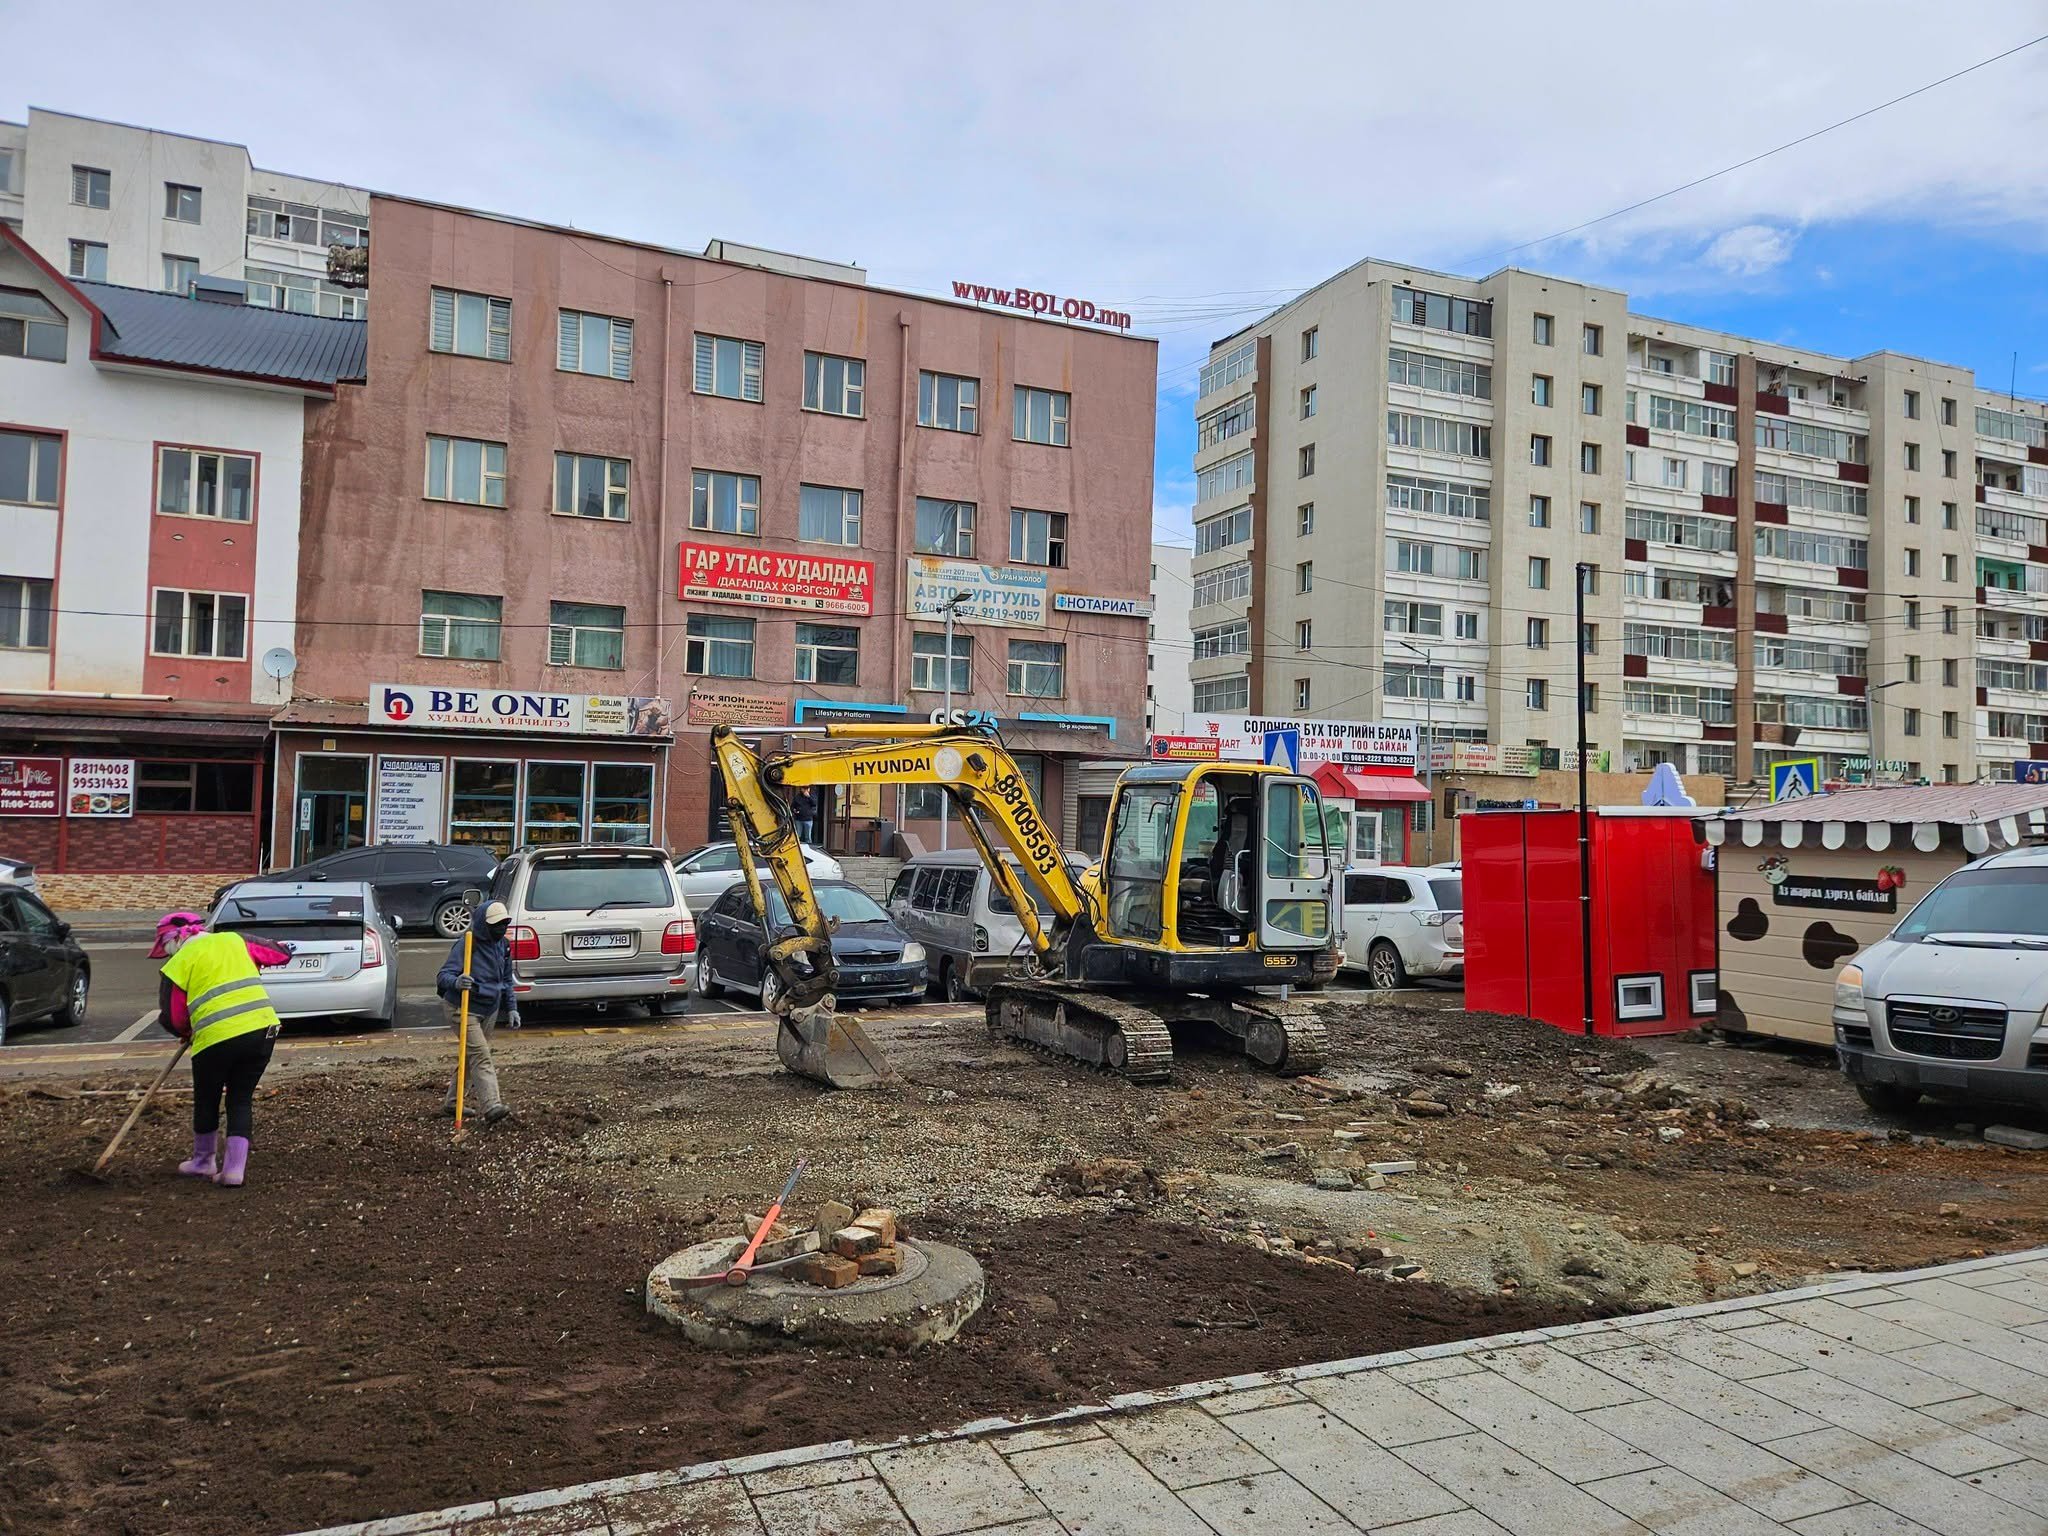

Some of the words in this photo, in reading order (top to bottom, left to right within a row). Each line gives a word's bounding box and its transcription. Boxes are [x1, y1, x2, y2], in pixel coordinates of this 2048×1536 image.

[952, 281, 1131, 329] www.BOLOD.mn
[685, 548, 720, 570] ГАР
[725, 552, 771, 576] УТАС
[775, 558, 868, 586] ХУДАЛДАА
[914, 584, 957, 599] АВТО
[825, 601, 867, 612] 9666-6005
[1067, 597, 1135, 613] НОТАРИАТ
[428, 690, 479, 714] BE
[492, 694, 571, 719] ONE
[428, 714, 492, 724] ХУДАЛДАА
[696, 710, 717, 718] ГАР
[722, 711, 749, 720] УТАС
[843, 711, 871, 719] Platform
[1304, 723, 1324, 736] БҮХ
[1327, 724, 1375, 739] ТӨРЛИЙН
[1378, 727, 1412, 741] БАРАА
[1352, 740, 1368, 750] ГОО
[1373, 741, 1408, 752] САЙХАН
[73, 763, 129, 774] 88114008
[853, 757, 931, 776] HYUNDAI
[72, 778, 129, 789] 99531432
[997, 774, 1057, 875] 88109593
[1856, 890, 1890, 902] байдаг
[577, 936, 600, 946] 7837
[1266, 957, 1297, 966] 555-7
